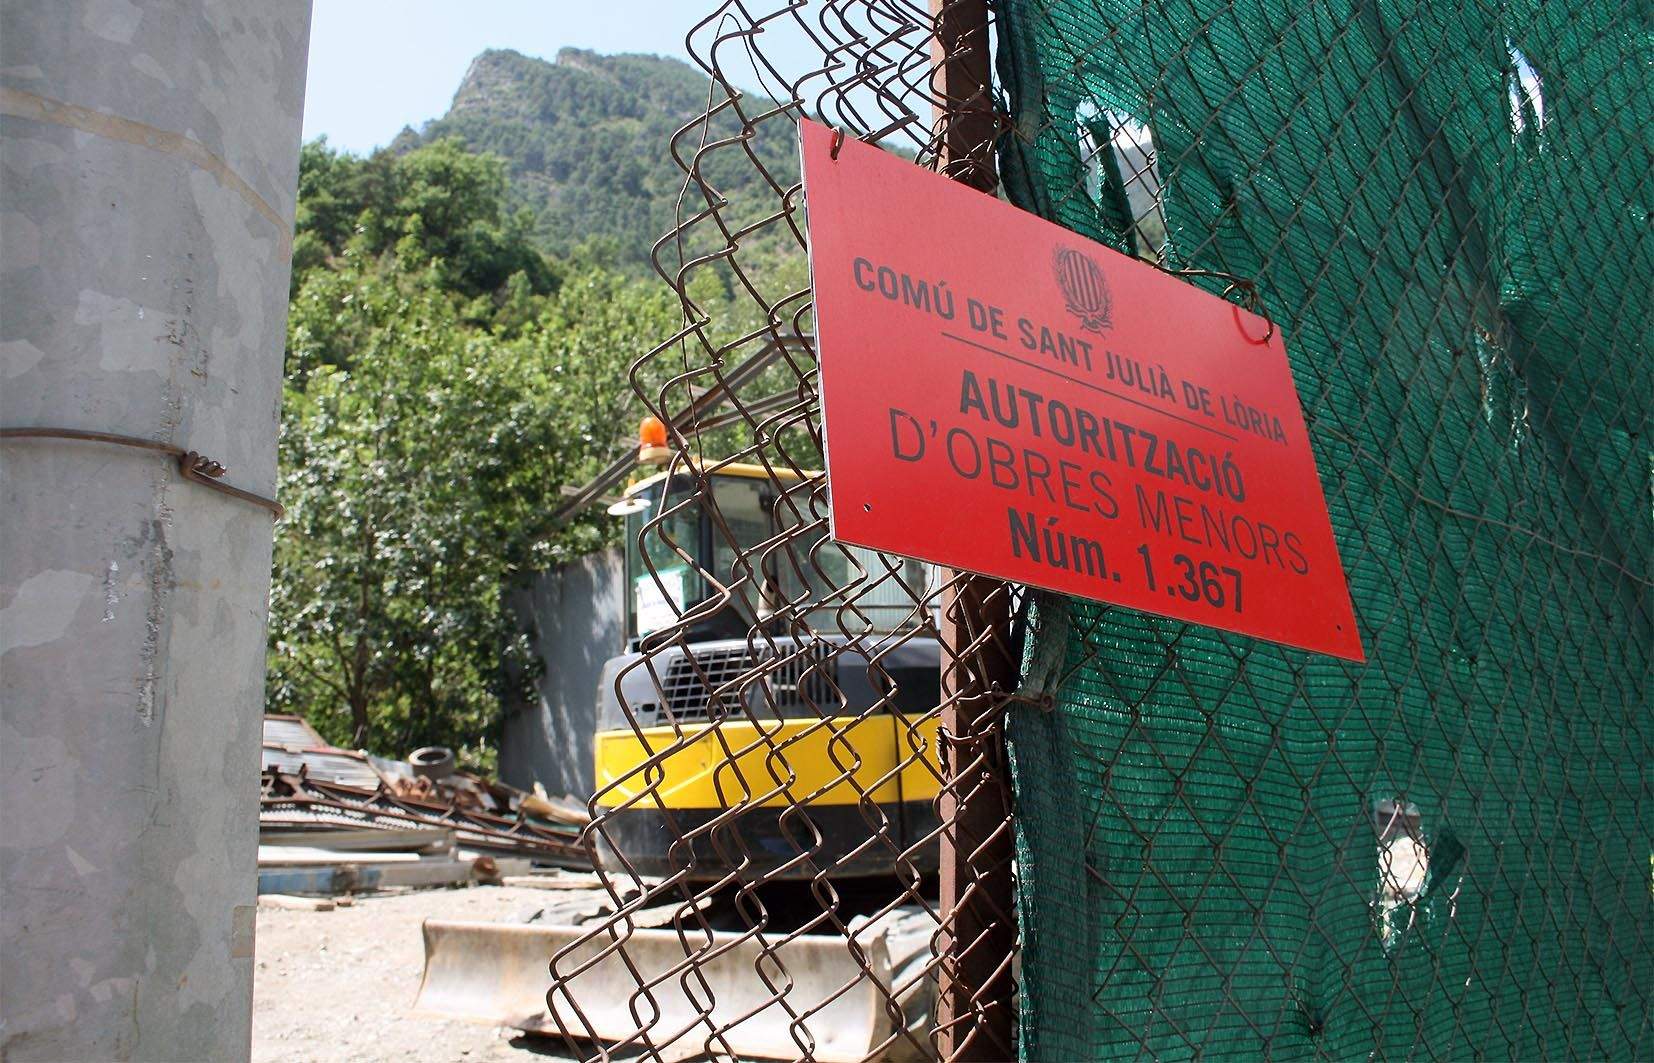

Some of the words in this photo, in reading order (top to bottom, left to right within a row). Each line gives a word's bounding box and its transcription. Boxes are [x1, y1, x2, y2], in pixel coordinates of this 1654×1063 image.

[853, 257, 954, 320] COMÚ
[967, 297, 1007, 341] DE
[1018, 319, 1092, 372] SANT
[1106, 350, 1174, 402] JULIÀ
[1183, 380, 1216, 418] DE
[1220, 393, 1287, 446] LÒRIA
[889, 407, 1119, 519] D'OBRES
[1137, 484, 1309, 575] MENORS
[960, 369, 1246, 503] AUTORITZACIÓ
[1008, 507, 1121, 583] Núm.
[1138, 543, 1245, 613] 1.367
